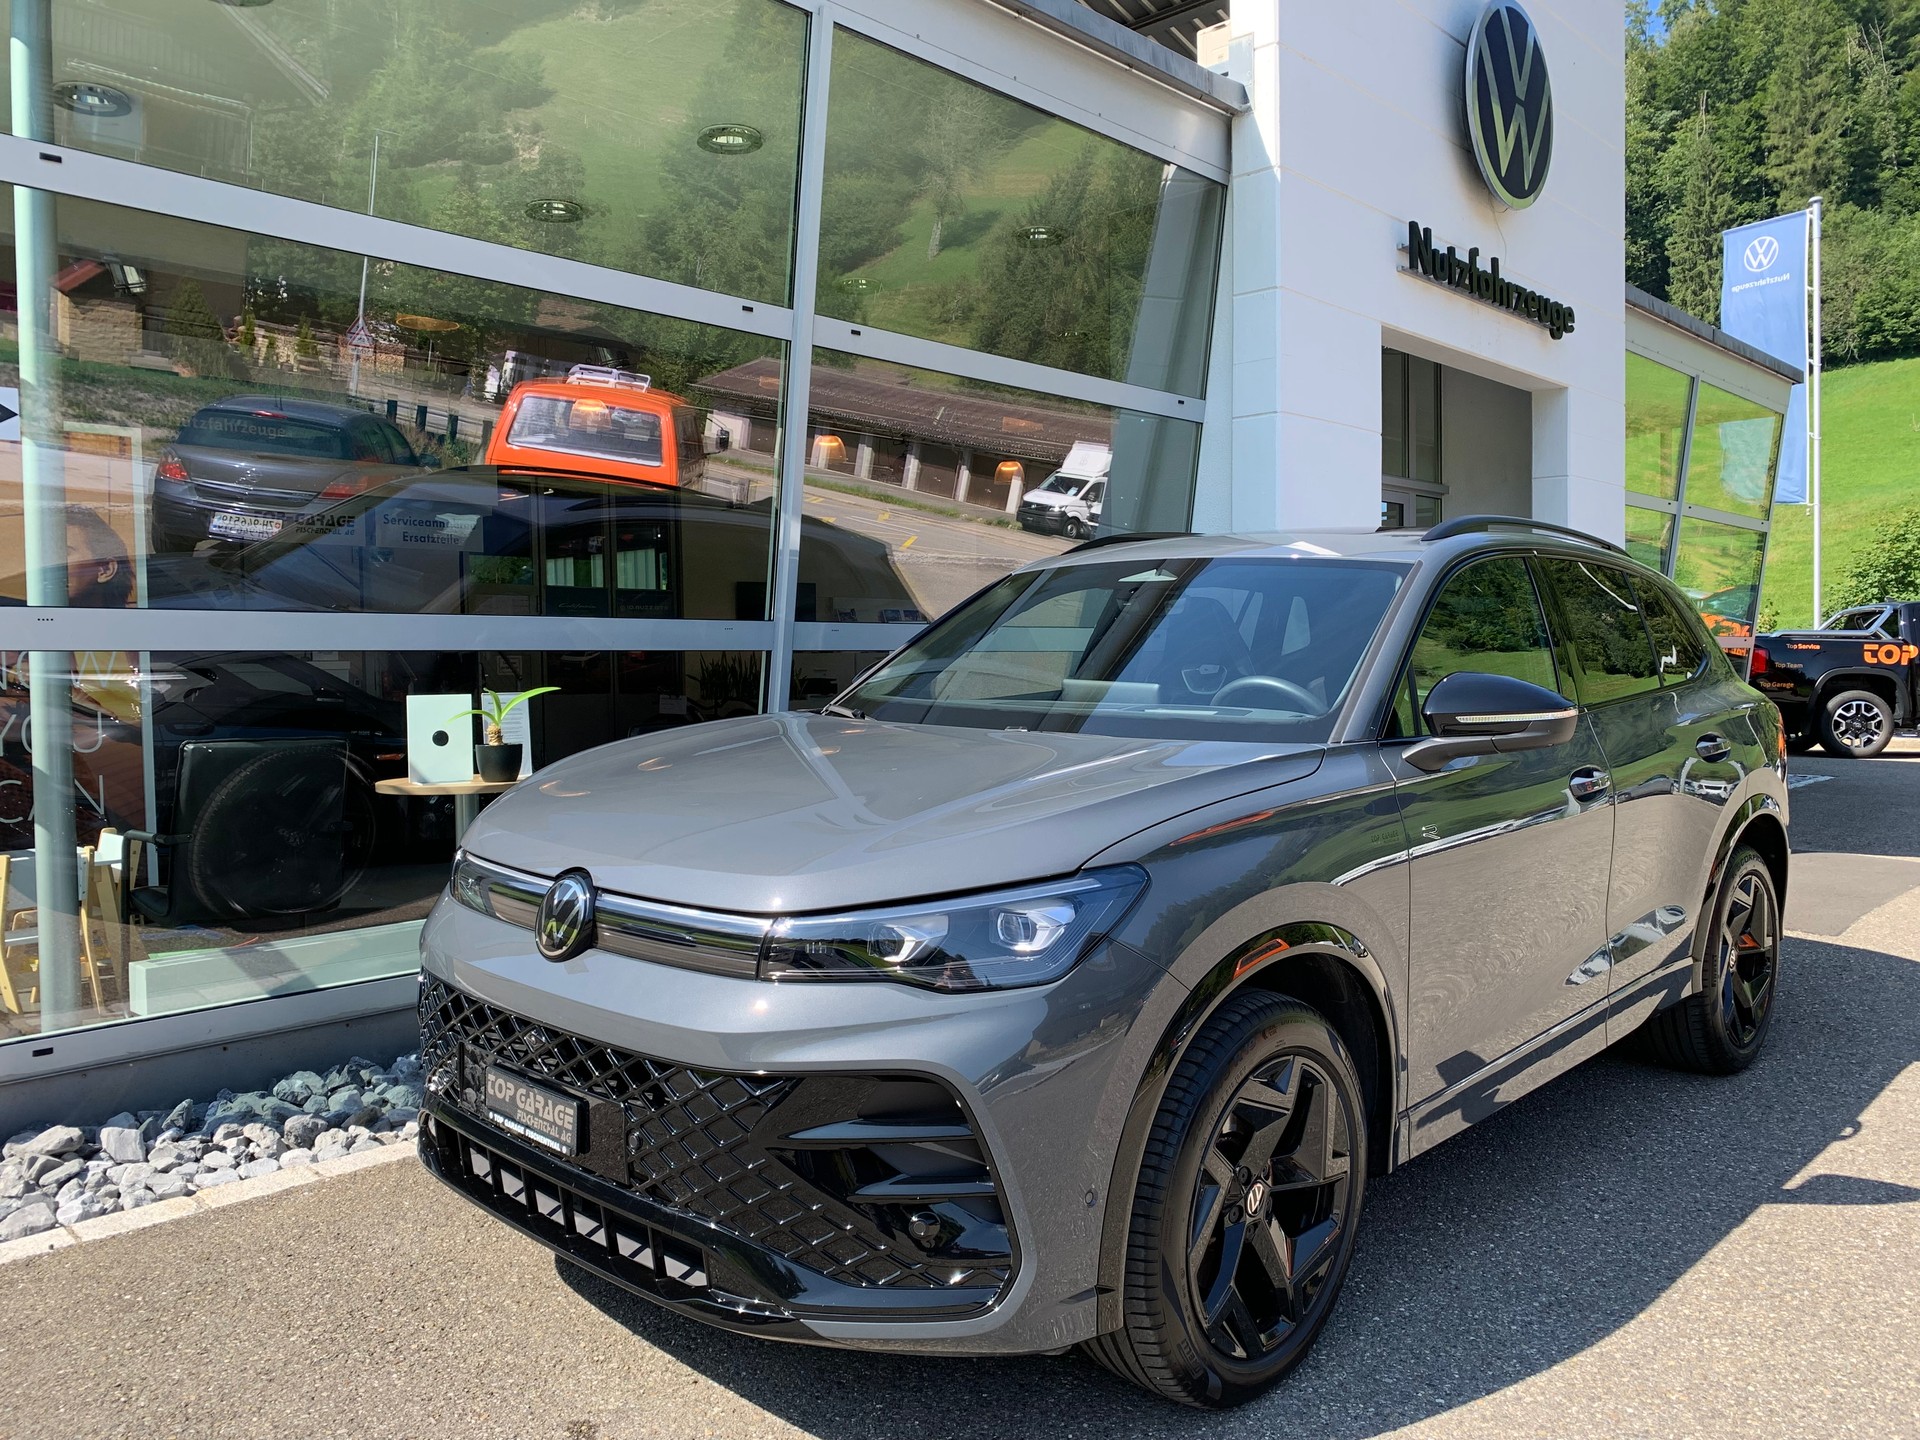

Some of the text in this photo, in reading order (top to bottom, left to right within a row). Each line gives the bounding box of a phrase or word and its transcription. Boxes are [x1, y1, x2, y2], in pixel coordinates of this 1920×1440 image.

[1408, 220, 1576, 340] Nutzfahrzeuge
[1863, 643, 1919, 666] TOP
[487, 1073, 574, 1130] TOP GARAGE
[493, 1113, 561, 1151] TOP GARAGE FISCHENTHAL
[560, 1129, 572, 1144] AG
